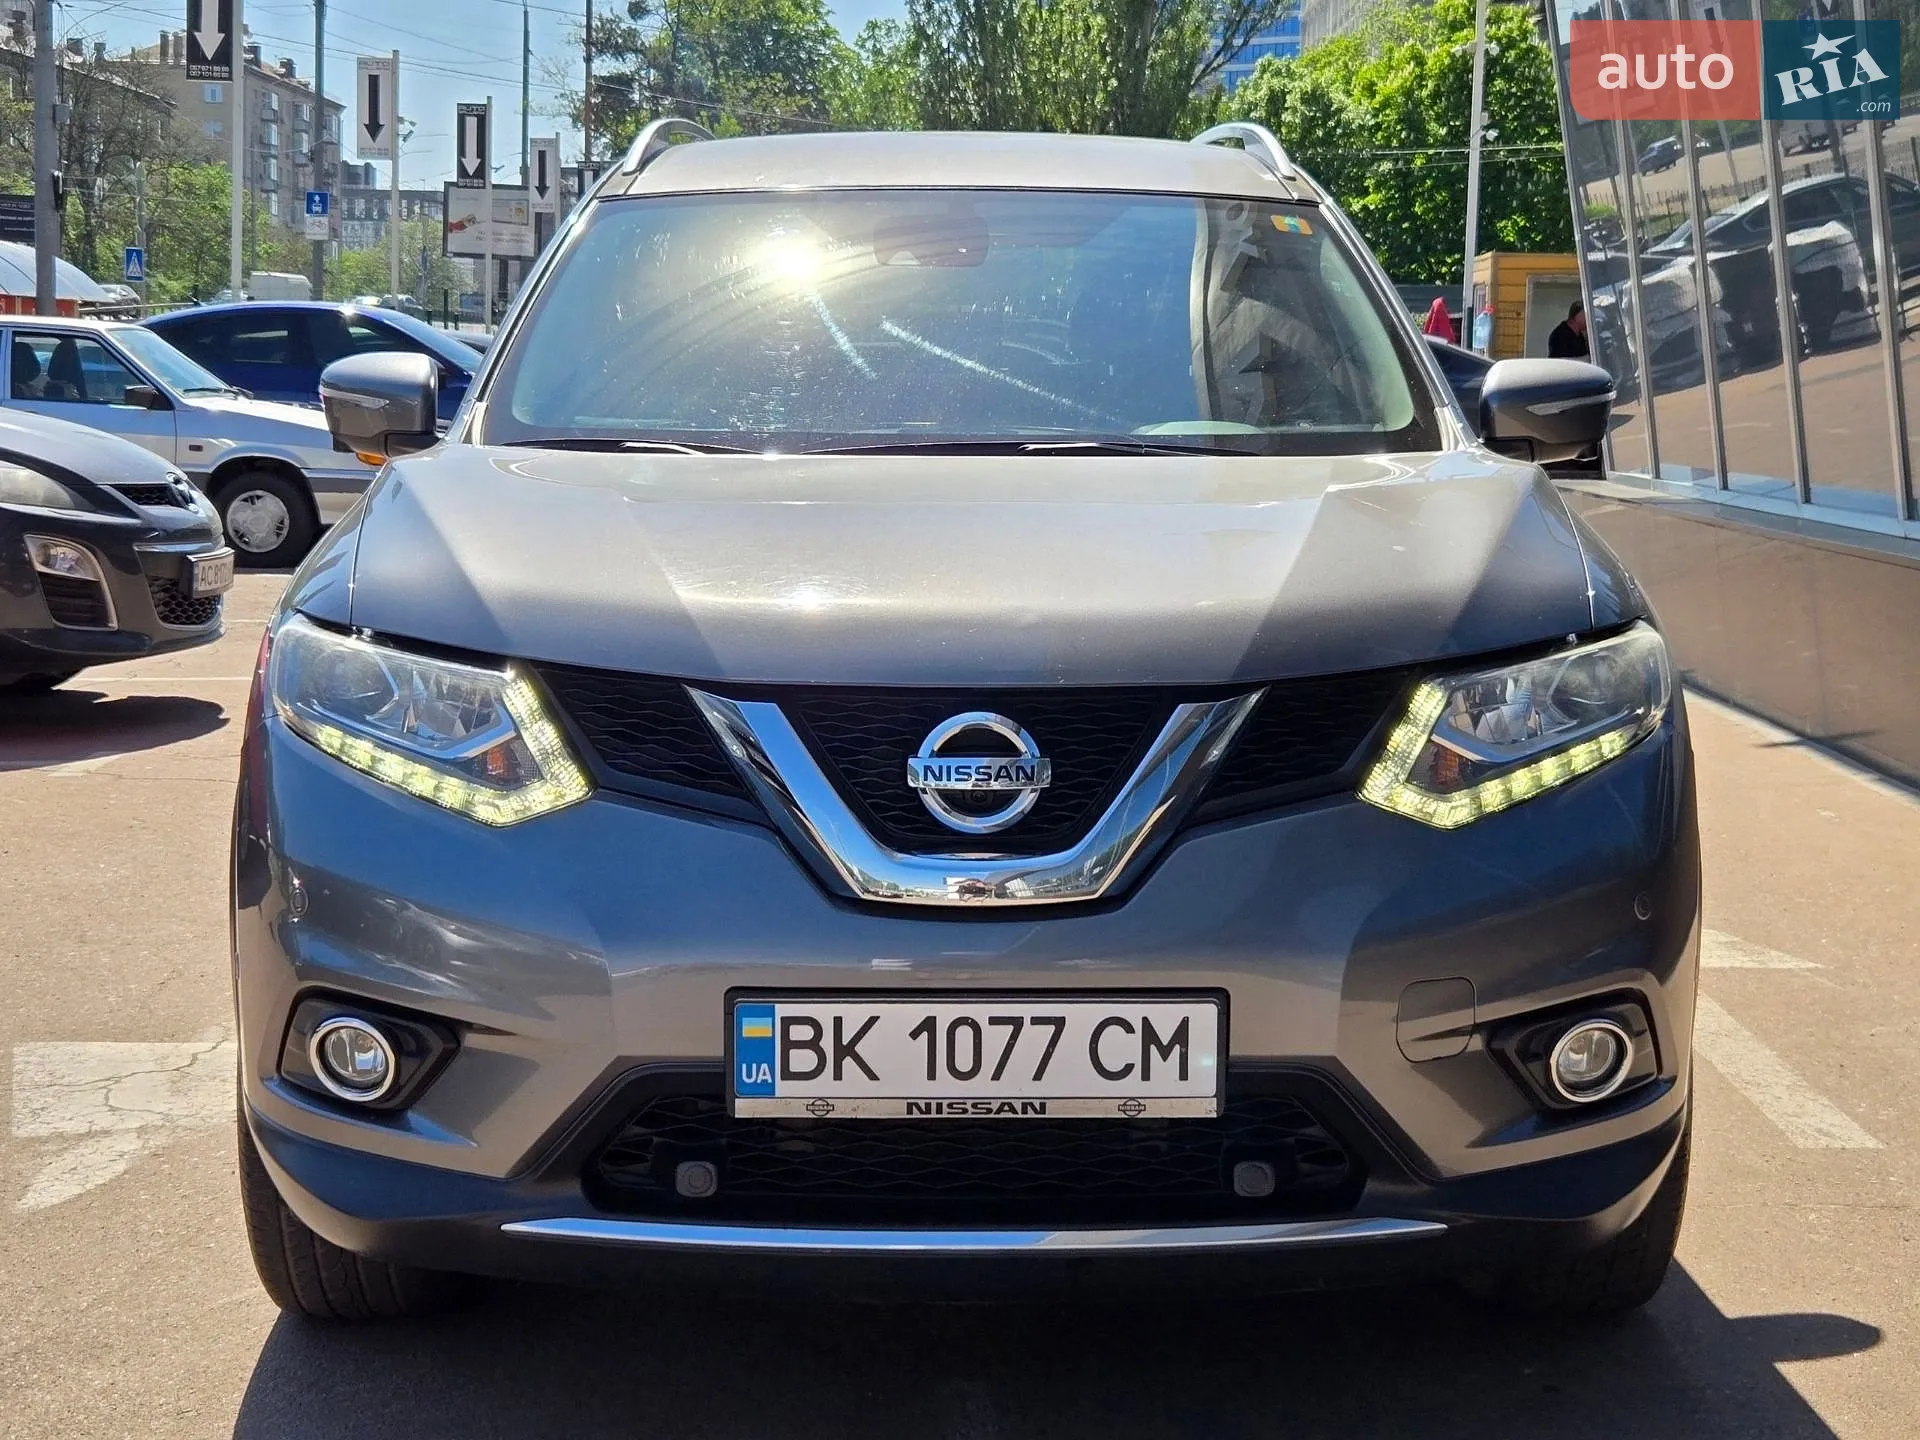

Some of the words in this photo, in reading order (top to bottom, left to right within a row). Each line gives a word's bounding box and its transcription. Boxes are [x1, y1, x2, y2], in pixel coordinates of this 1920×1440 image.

[923, 765, 1035, 782] NISSAN
[780, 1016, 881, 1081] BK
[908, 1016, 1066, 1081] 1077
[1088, 1016, 1190, 1081] CM
[742, 1063, 772, 1084] UA
[906, 1101, 1047, 1115] NISSAN
